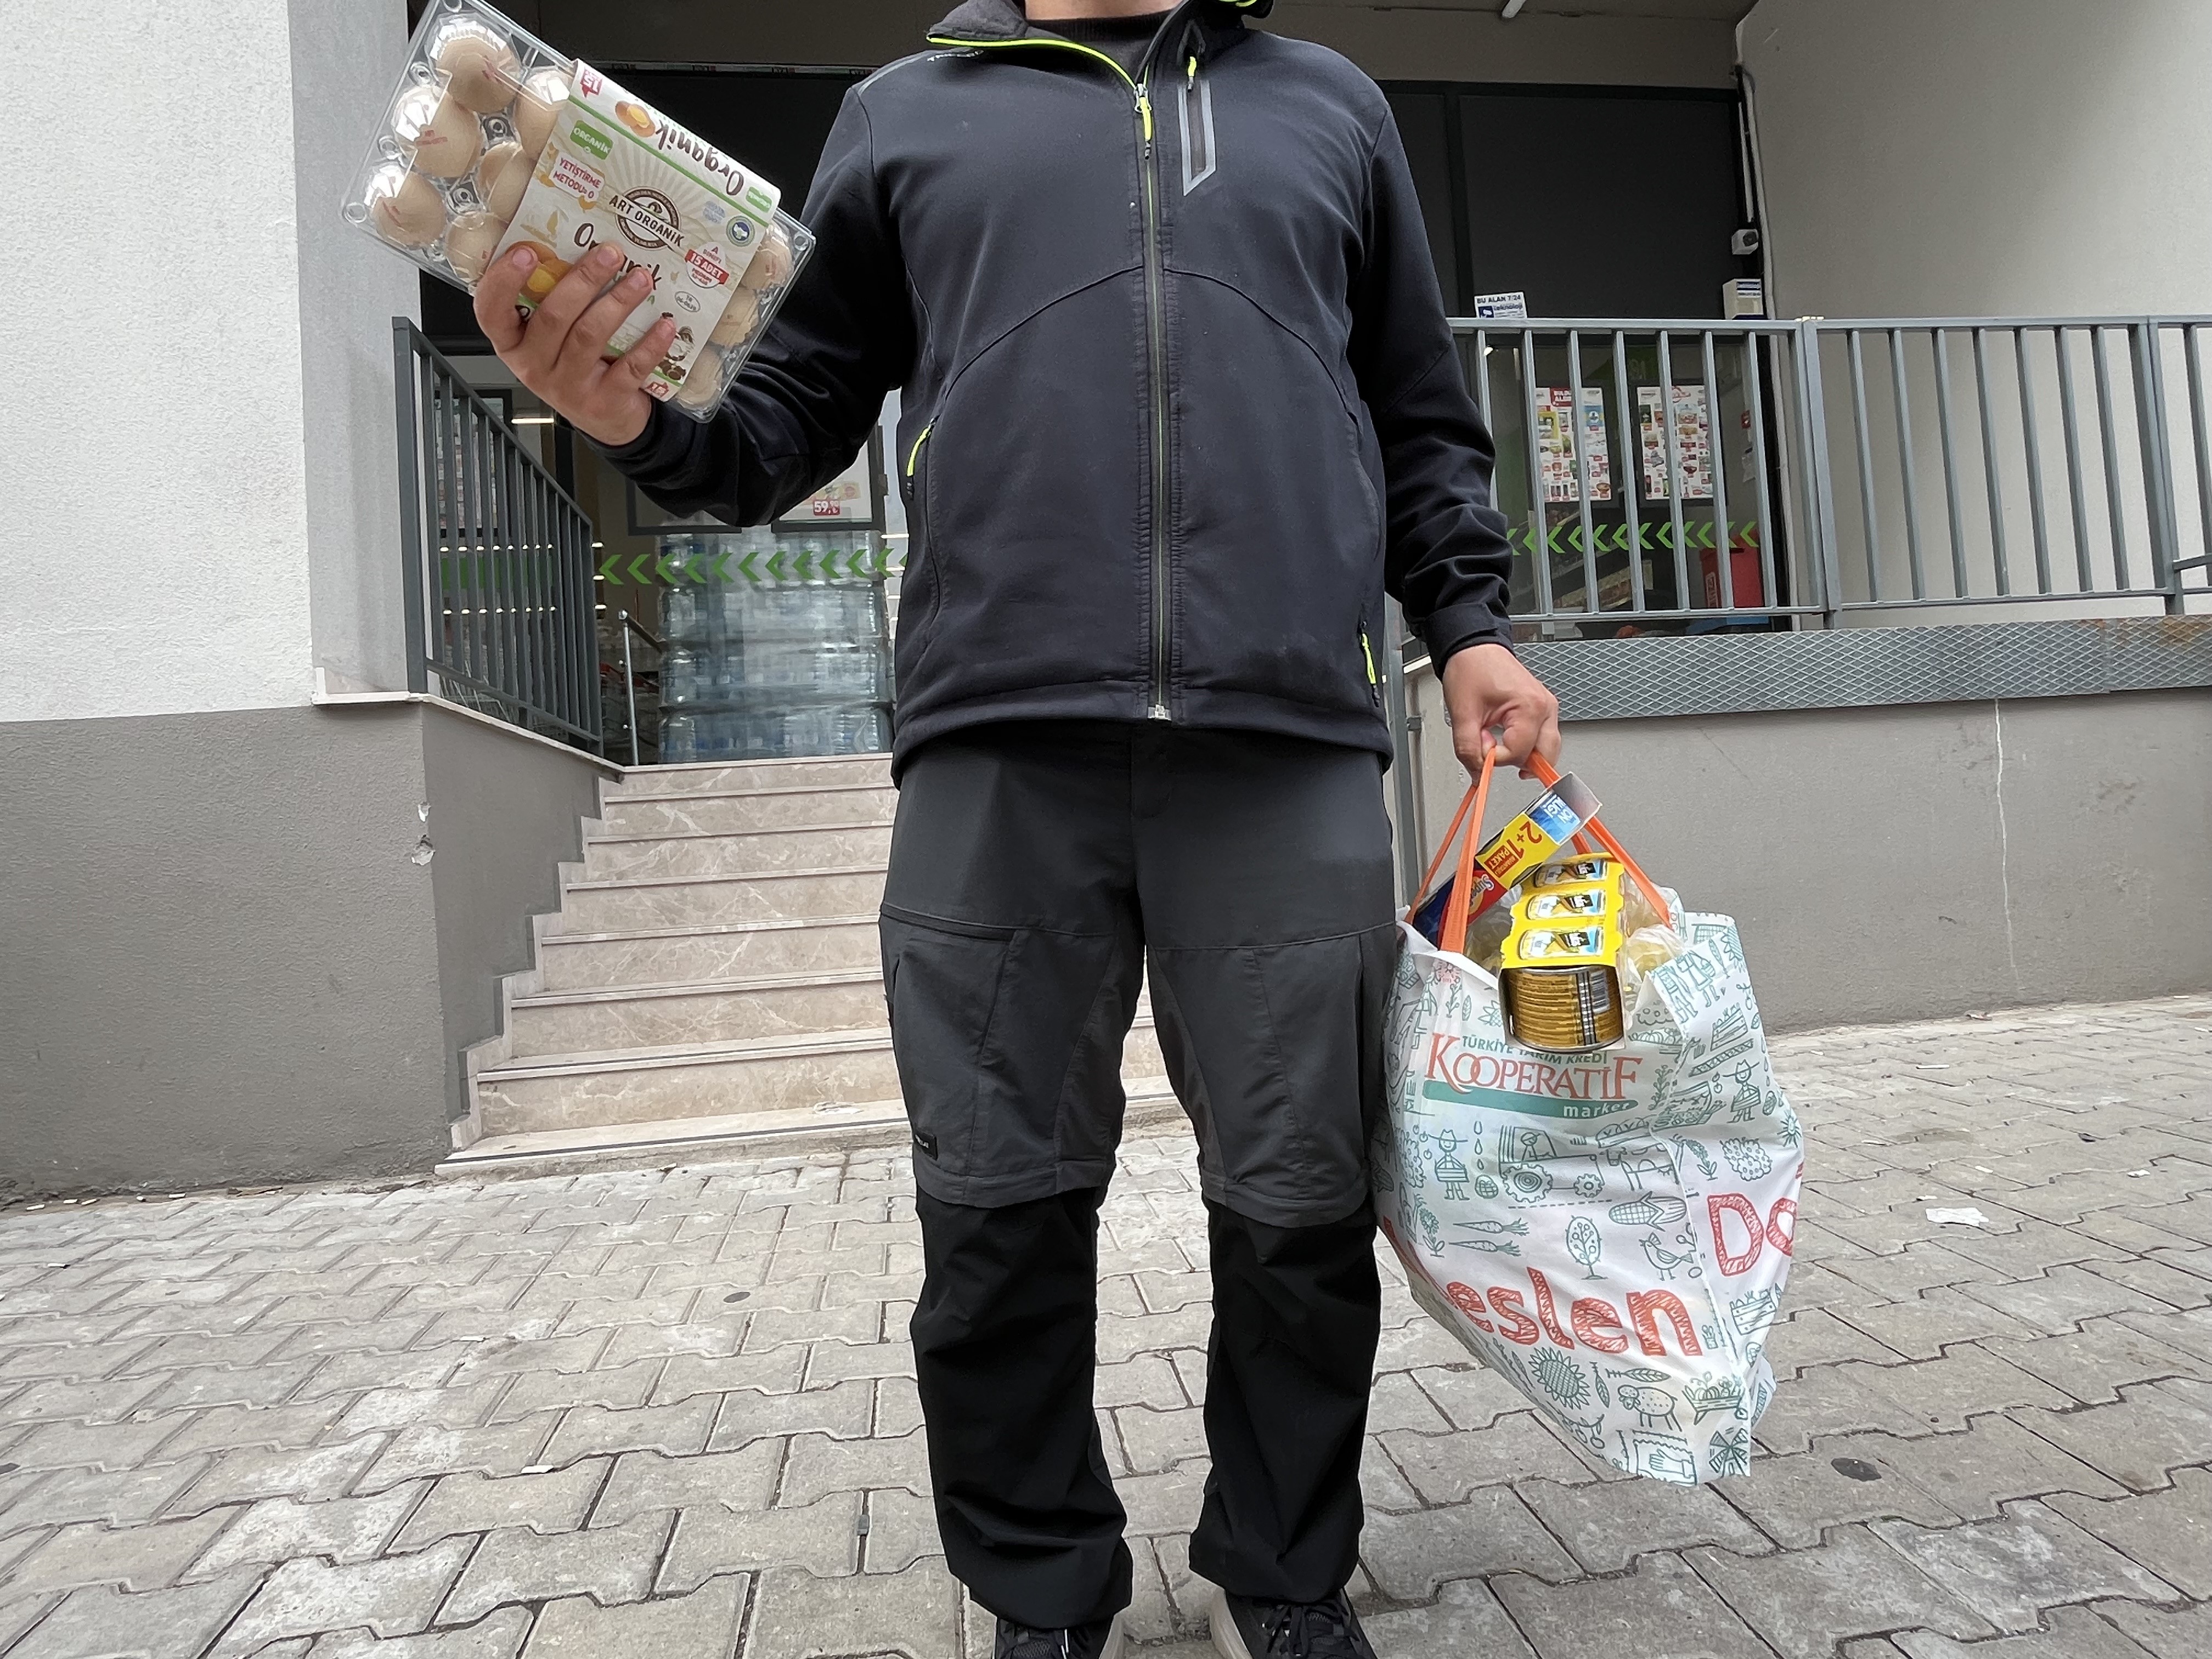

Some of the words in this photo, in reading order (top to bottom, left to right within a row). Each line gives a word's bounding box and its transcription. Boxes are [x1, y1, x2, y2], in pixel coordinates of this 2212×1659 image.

[656, 119, 744, 196] Organik
[559, 157, 601, 188] YETİŞTİRME
[609, 195, 634, 214] ART
[690, 252, 703, 266] 15
[701, 261, 723, 279] ADET
[1489, 847, 1510, 870] PAKET
[1462, 1034, 1513, 1054] TÜRKİYE
[1424, 1032, 1644, 1099] KOOPERATİF
[1564, 1101, 1630, 1118] market
